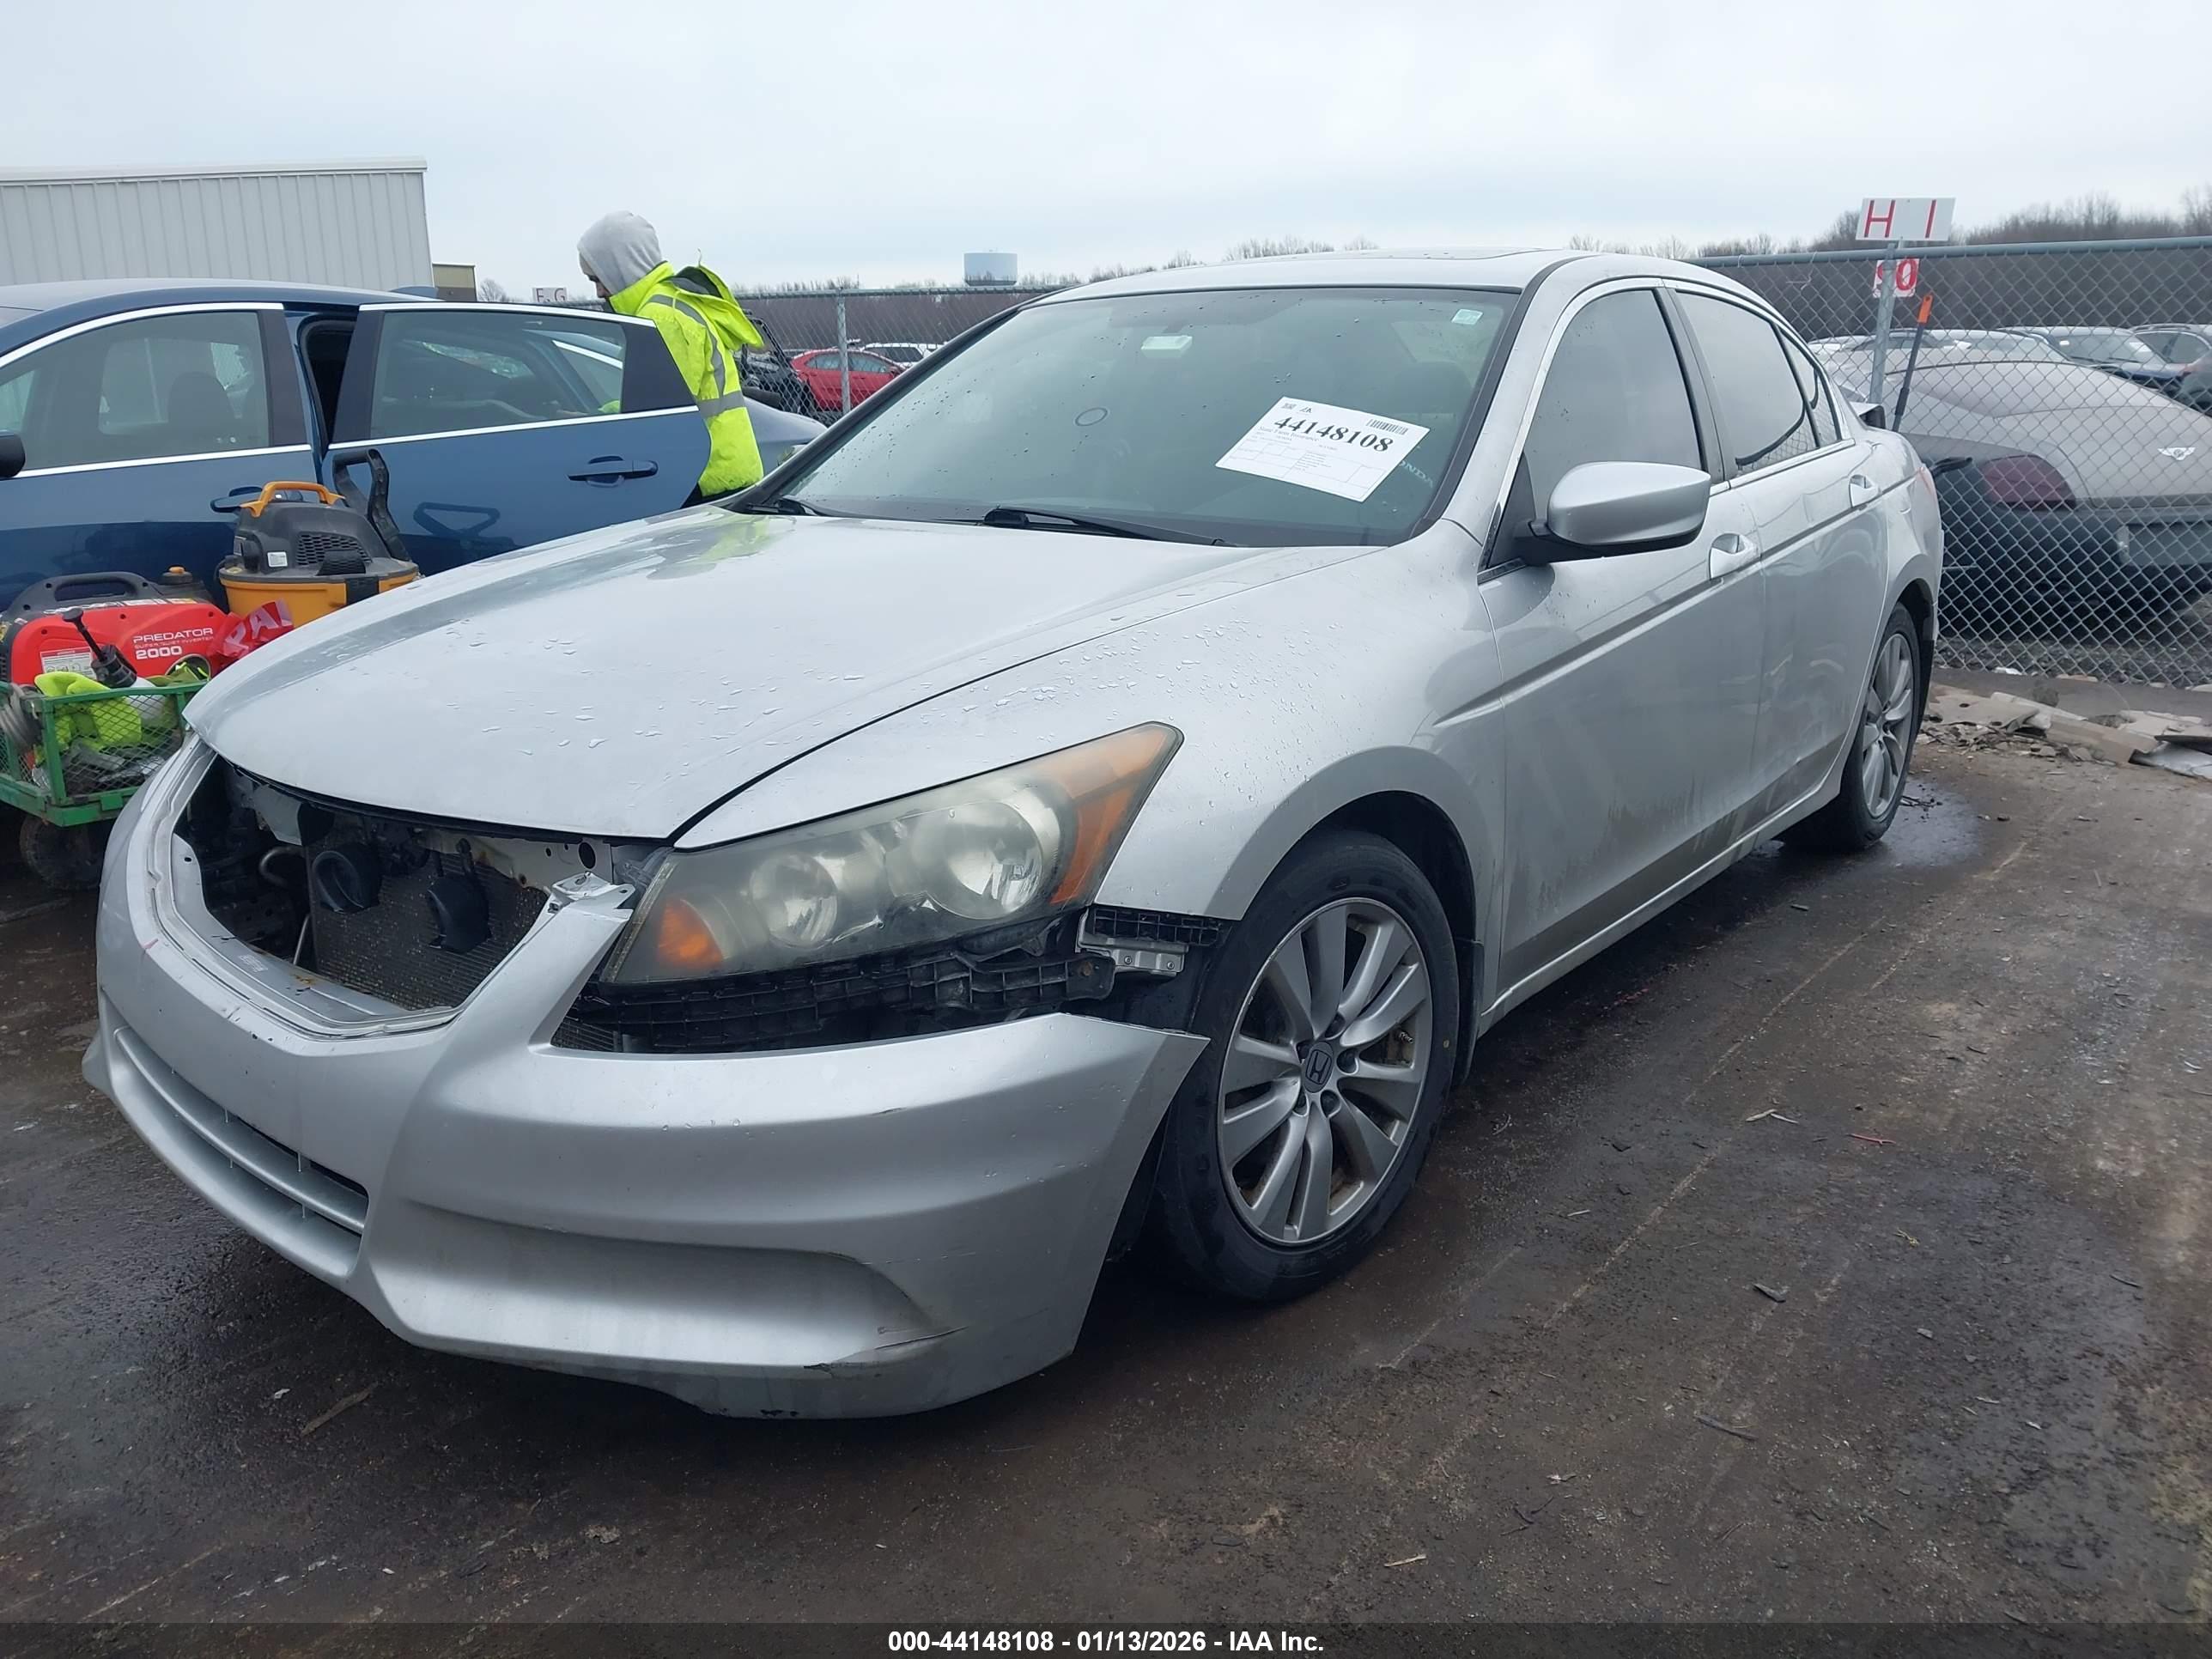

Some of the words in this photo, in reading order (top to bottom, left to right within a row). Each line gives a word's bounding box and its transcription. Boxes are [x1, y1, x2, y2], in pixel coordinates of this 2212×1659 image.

[1863, 199, 1896, 238] H
[1274, 416, 1394, 452] 44148108
[132, 627, 214, 644] PREDATOR
[135, 645, 183, 660] 2000
